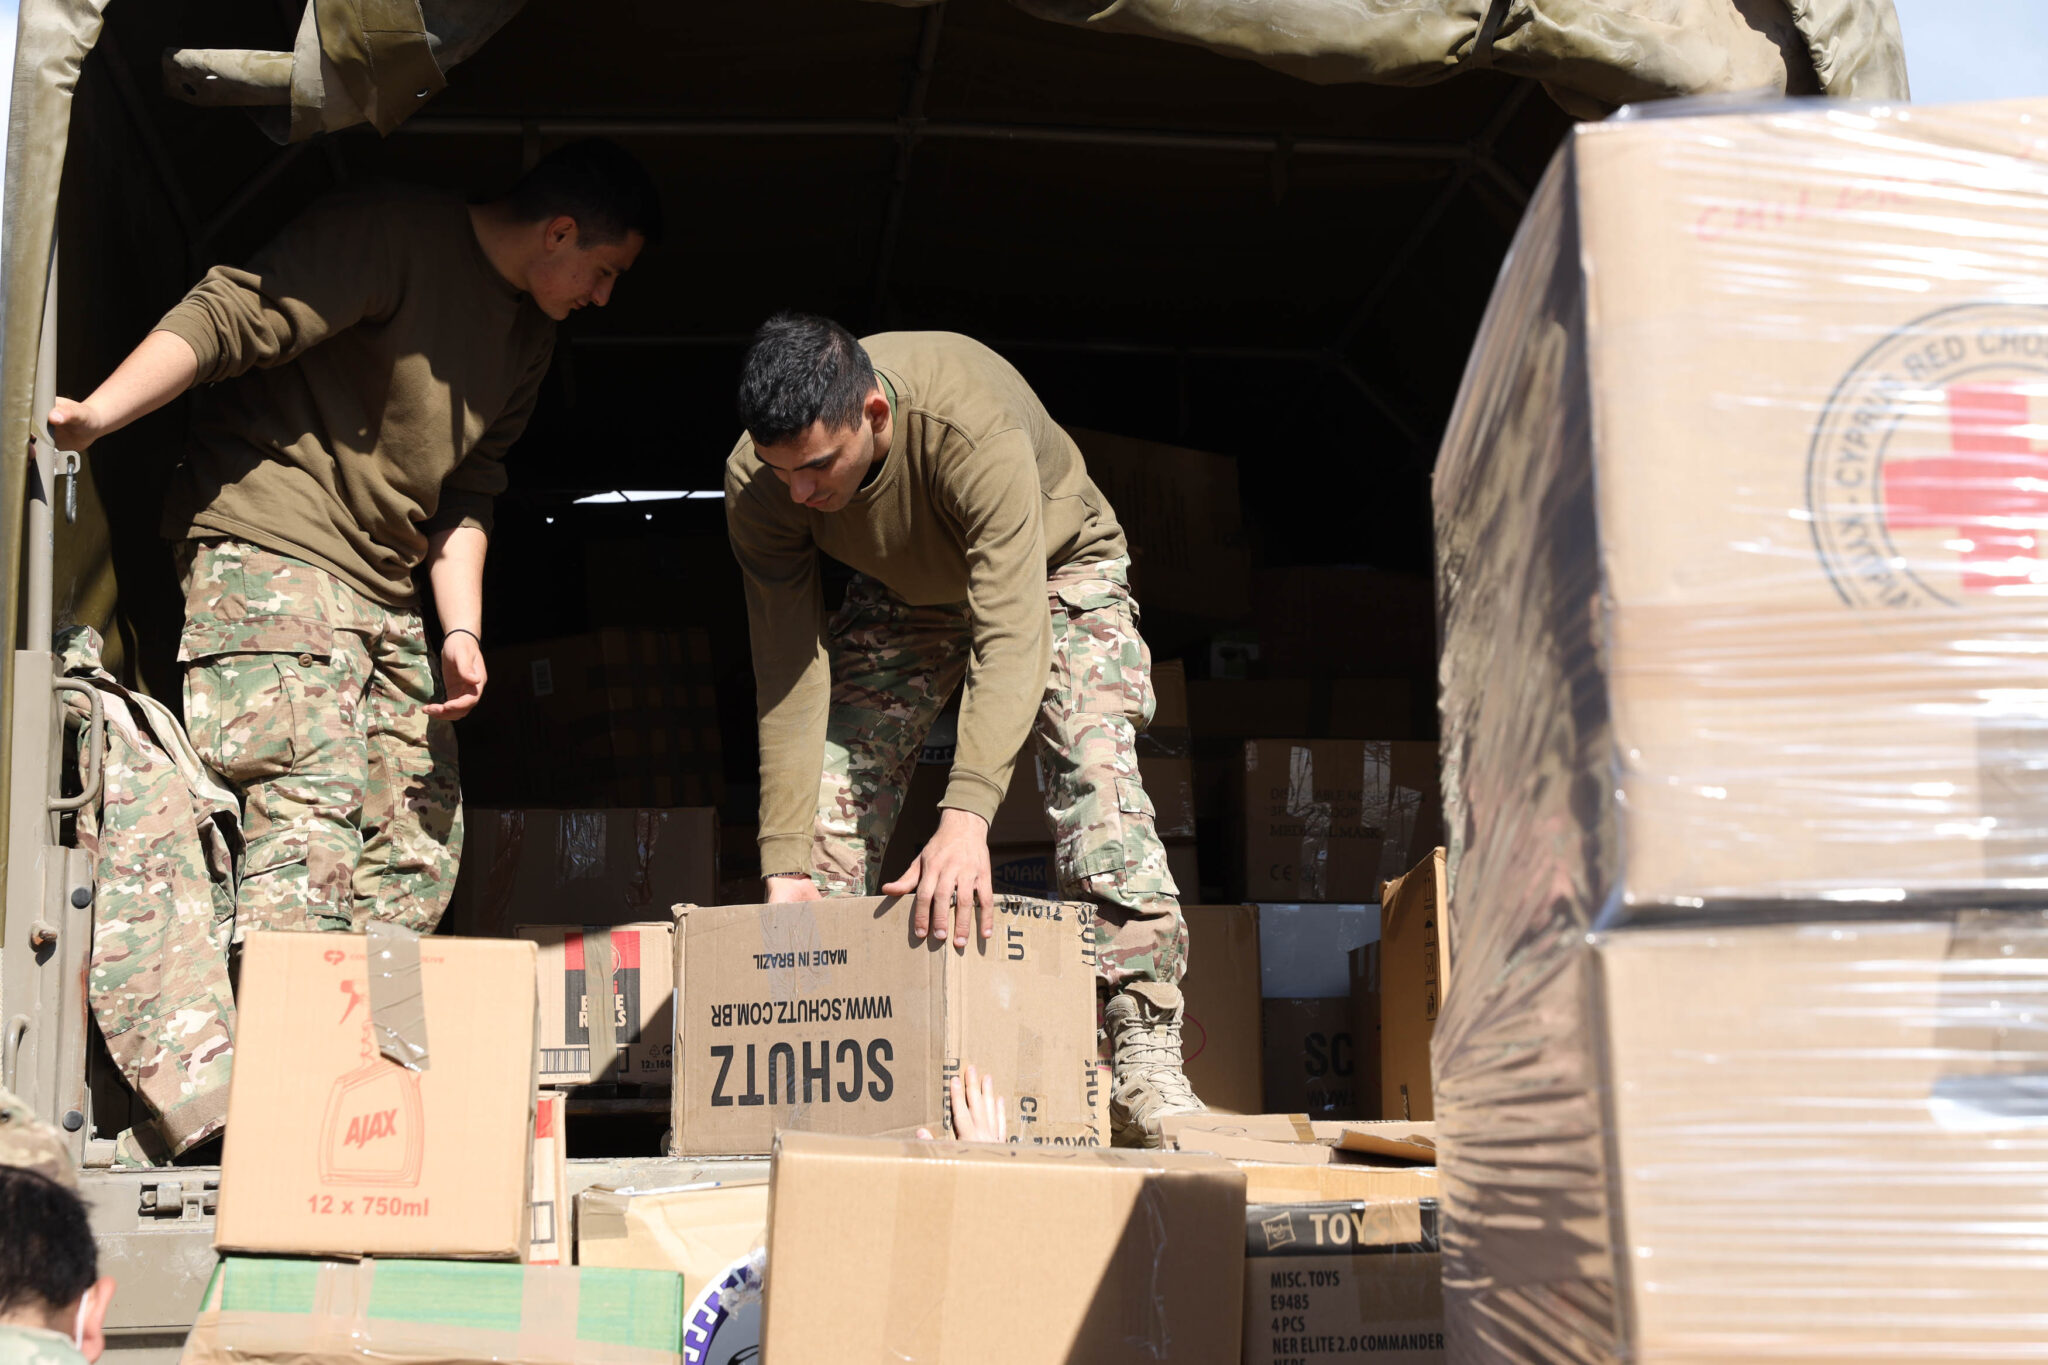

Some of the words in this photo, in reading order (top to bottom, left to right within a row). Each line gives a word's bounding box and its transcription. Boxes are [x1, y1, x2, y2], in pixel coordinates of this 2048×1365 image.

[1902, 335, 1966, 380] RED
[1270, 823, 1337, 838] MEDIL
[753, 952, 796, 970] BRAZIL
[798, 951, 810, 967] IN
[813, 949, 848, 967] MADE
[711, 996, 893, 1027] WWW.SCHUTZ.COM.BR
[711, 1039, 894, 1107] SCHUTZ
[343, 1107, 398, 1150] AJAX
[308, 1194, 334, 1214] 12
[341, 1200, 354, 1214] x
[362, 1196, 430, 1217] 750ml
[1271, 1271, 1306, 1289] MISC.
[1309, 1271, 1340, 1287] TOYS
[1271, 1294, 1309, 1310] E9485
[1271, 1318, 1279, 1333] 4
[1282, 1316, 1305, 1332] PCS
[1273, 1337, 1301, 1354] NER
[1302, 1336, 1334, 1353] ELITE
[1338, 1336, 1358, 1352] 2.0
[1361, 1333, 1444, 1351] COMMANDER
